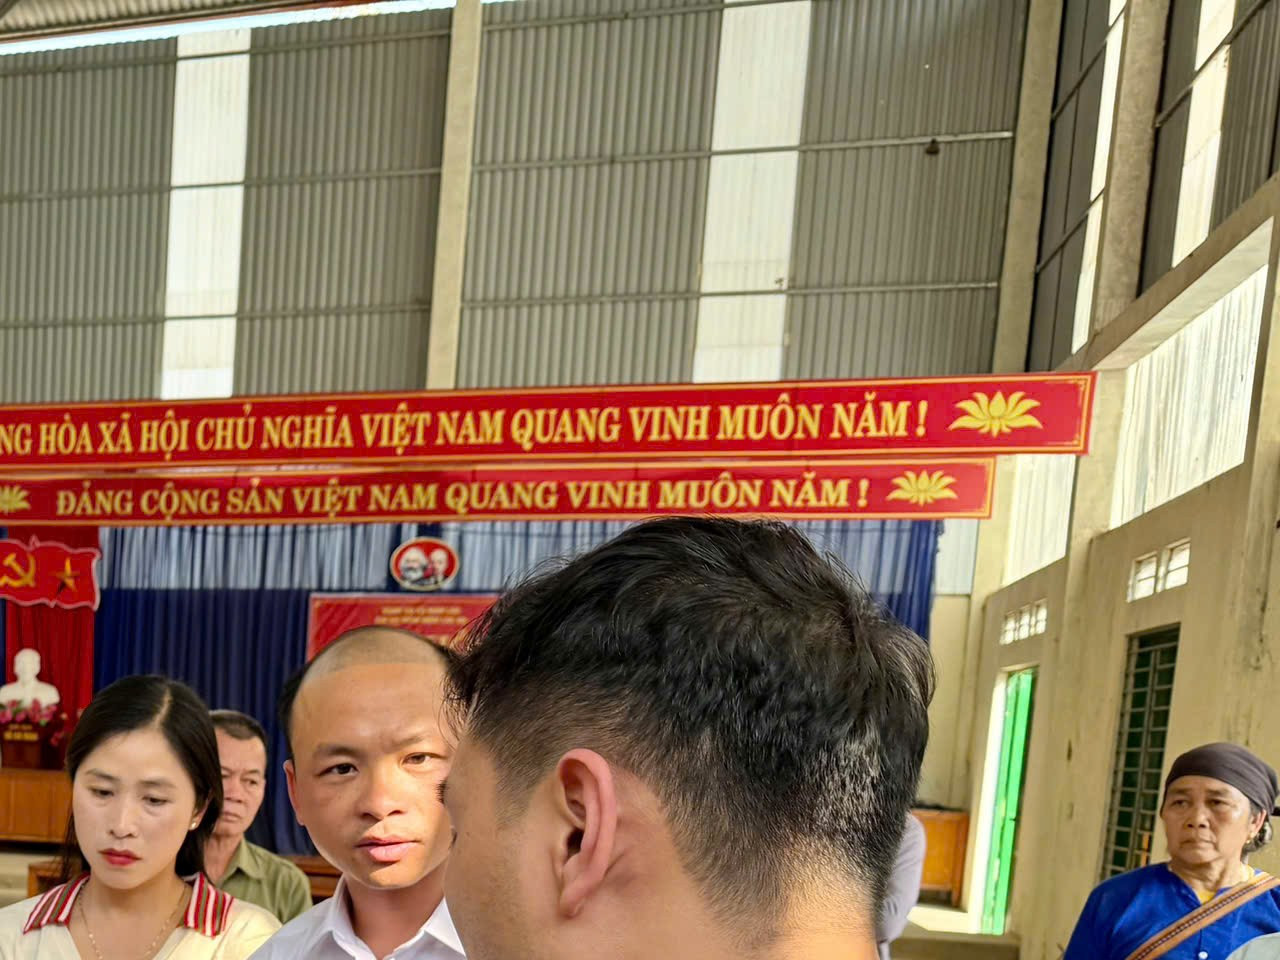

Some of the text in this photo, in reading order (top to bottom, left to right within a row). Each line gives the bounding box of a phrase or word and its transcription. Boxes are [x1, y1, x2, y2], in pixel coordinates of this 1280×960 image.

[38, 411, 94, 455] HÒA
[97, 411, 133, 453] XÃ
[139, 409, 190, 461] HỘI
[195, 402, 256, 450] CHỦ
[260, 405, 353, 449] NGHĨA
[360, 401, 431, 456] VIỆT
[436, 409, 505, 446] NAM
[510, 406, 621, 451] QUANG
[628, 404, 711, 441] VINH
[715, 392, 823, 440] MUÔN
[830, 391, 911, 438] NĂM
[56, 480, 134, 516] ĐẢNG
[140, 481, 220, 522] CỘNG
[226, 477, 283, 514] SẢN
[291, 477, 363, 519] VIỆT
[368, 483, 438, 511] NAM
[445, 480, 557, 514] QUANG
[566, 480, 650, 509] VINH
[657, 472, 763, 508] MUÔN
[770, 471, 852, 508] NĂM
